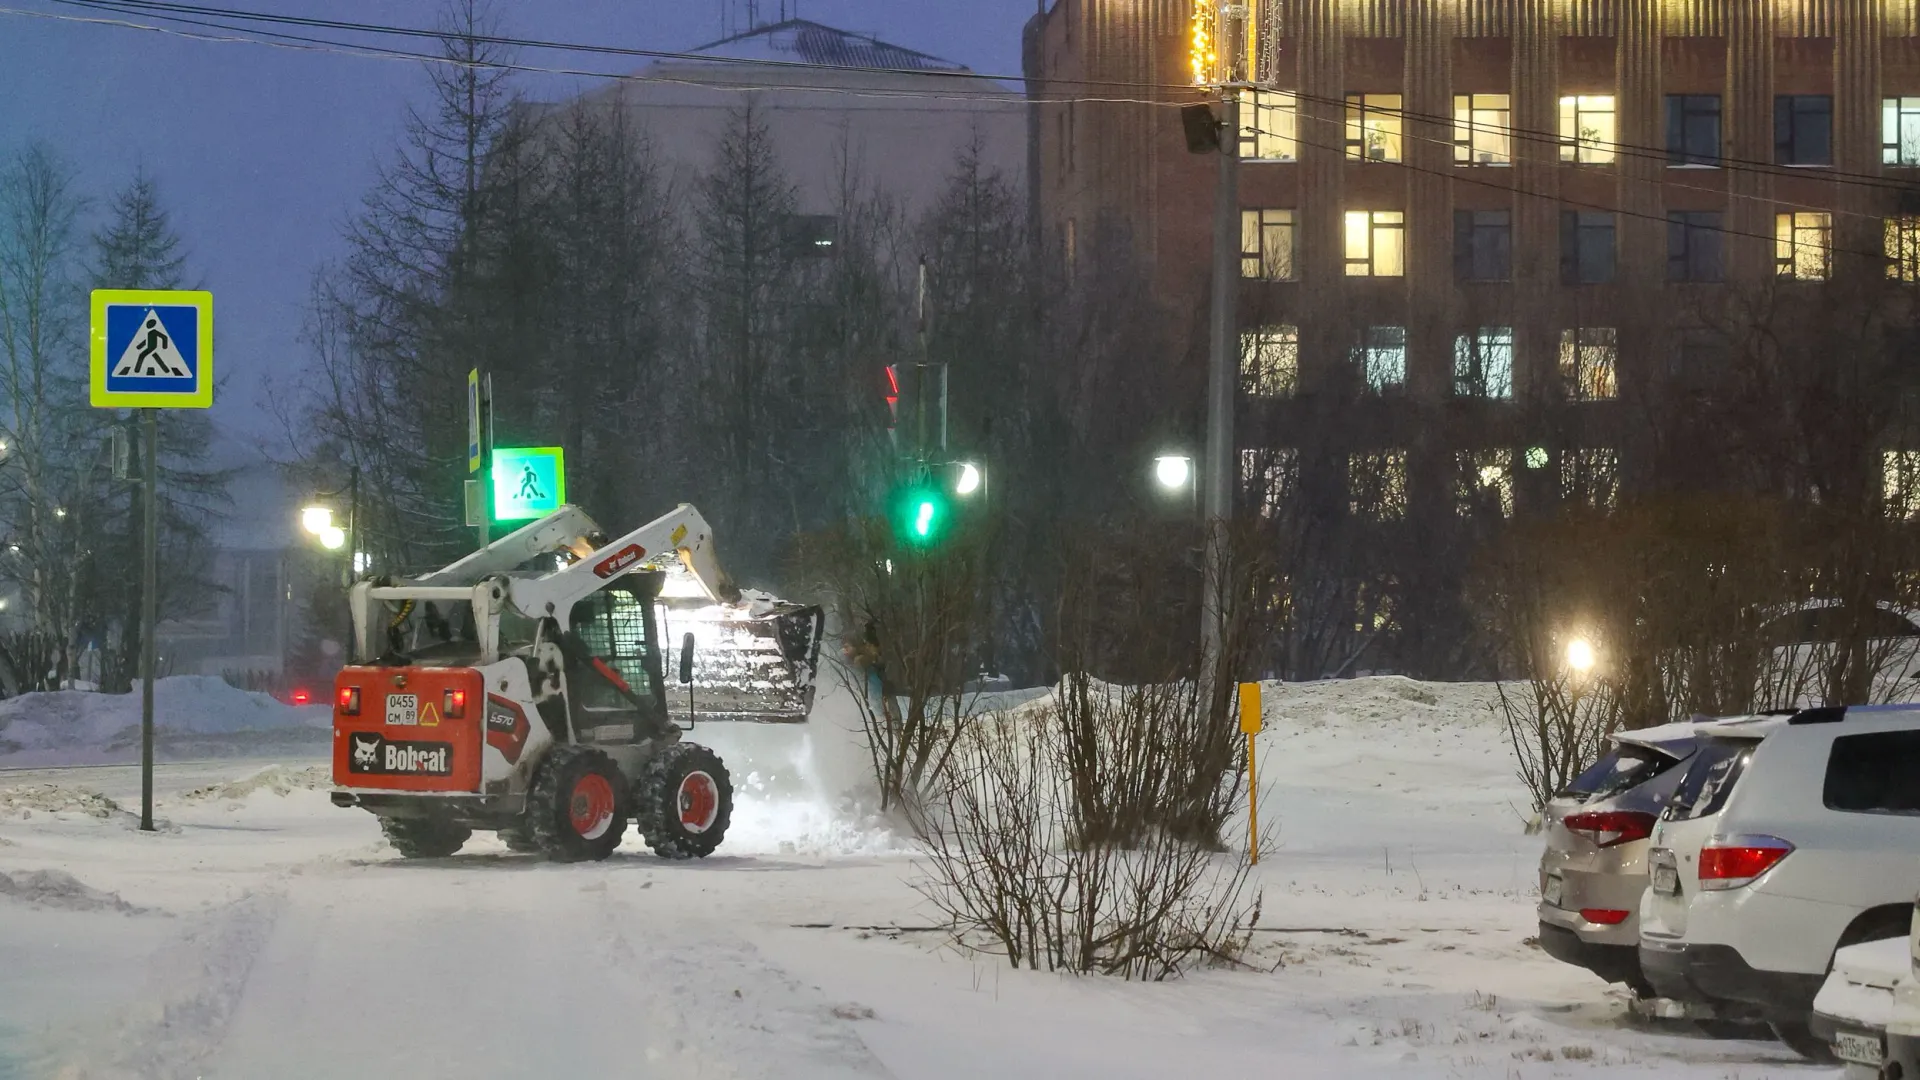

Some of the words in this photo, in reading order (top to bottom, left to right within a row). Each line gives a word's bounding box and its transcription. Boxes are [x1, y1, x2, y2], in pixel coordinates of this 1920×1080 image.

[390, 696, 414, 708] 0455
[405, 710, 415, 720] 89
[490, 711, 514, 726] S570
[385, 745, 446, 772] Bobcat
